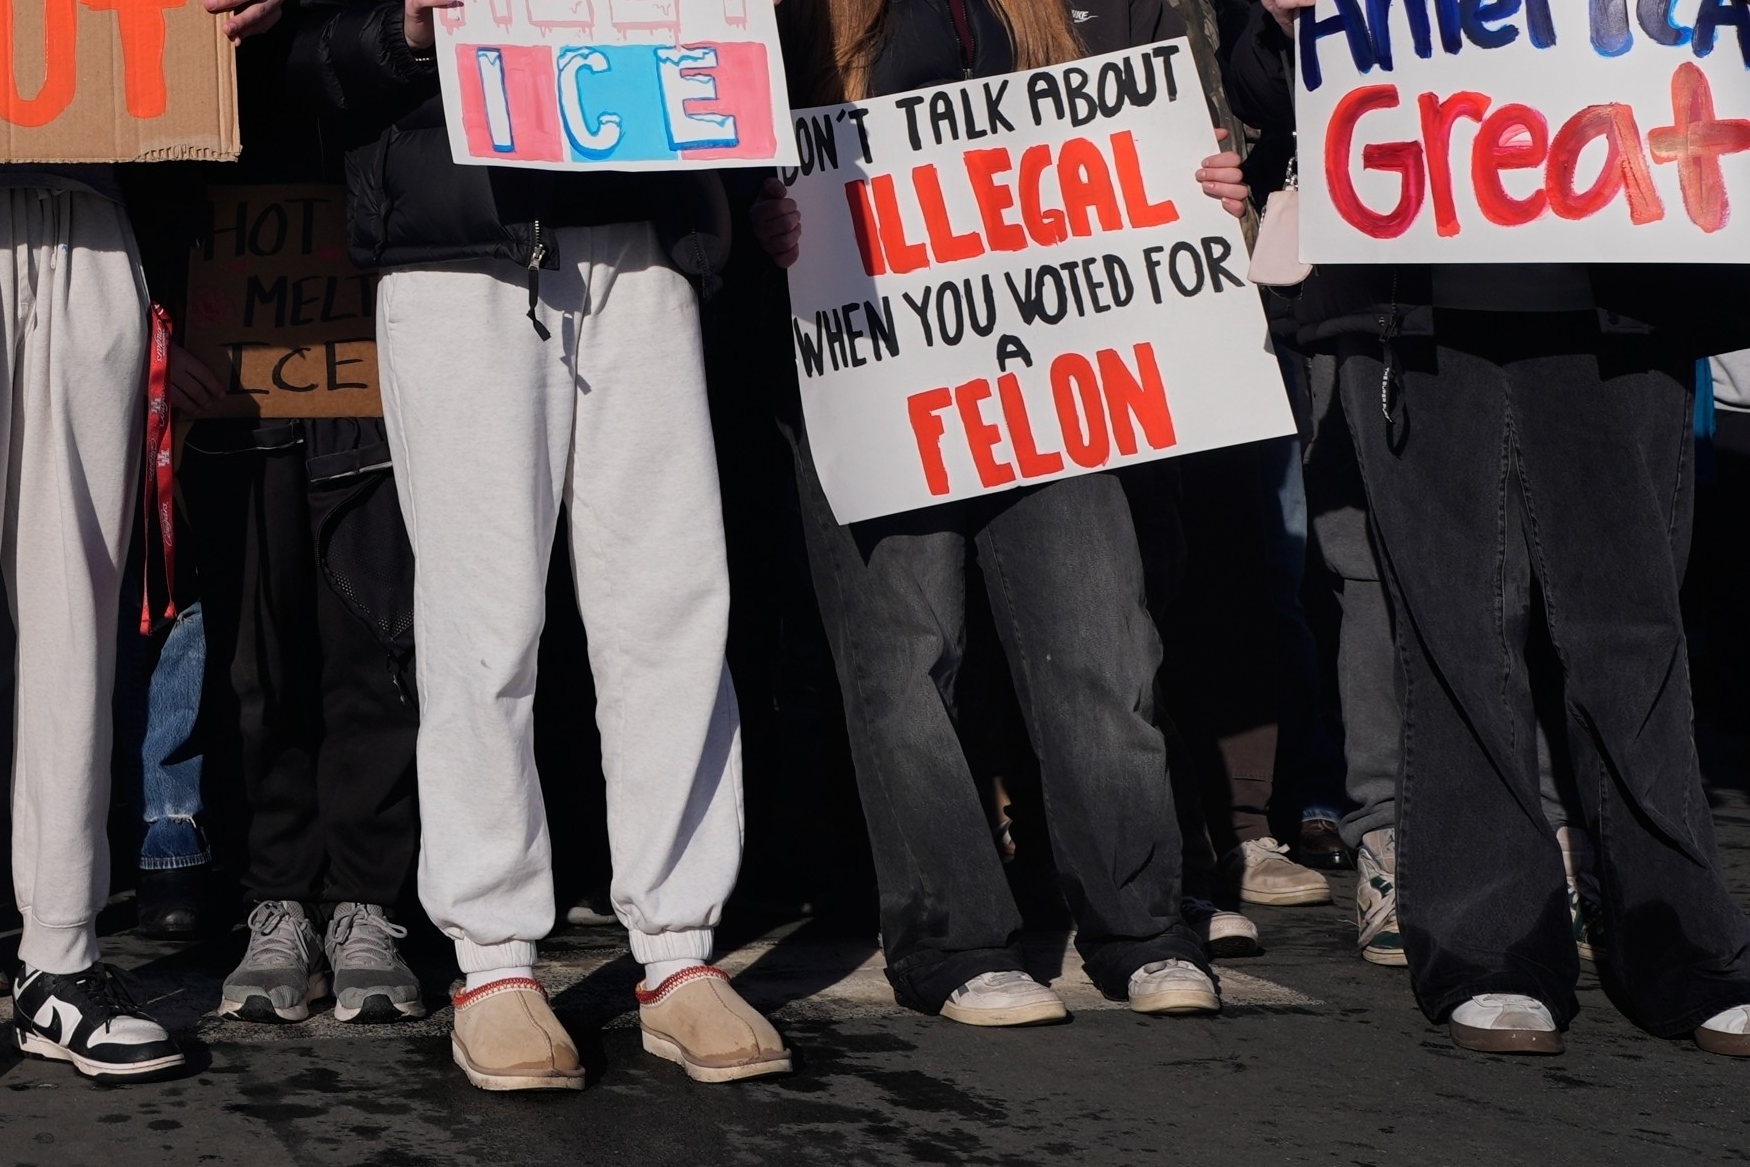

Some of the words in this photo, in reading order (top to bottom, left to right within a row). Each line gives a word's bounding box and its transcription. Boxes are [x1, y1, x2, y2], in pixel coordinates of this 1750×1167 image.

[476, 46, 739, 159] ICE
[896, 79, 1015, 151] TALK
[1026, 45, 1180, 129] ABOUT
[1325, 61, 1750, 240] Great
[203, 198, 331, 261] HOT
[845, 130, 1179, 277] ILLEGAL
[243, 272, 378, 328] MELT
[793, 296, 900, 379] WHEN
[902, 272, 996, 347] YOU
[1005, 254, 1133, 325] VOTED
[1147, 235, 1245, 305] FOR
[996, 334, 1033, 372] A
[219, 337, 377, 395] ICE
[907, 342, 1177, 496] FELON
